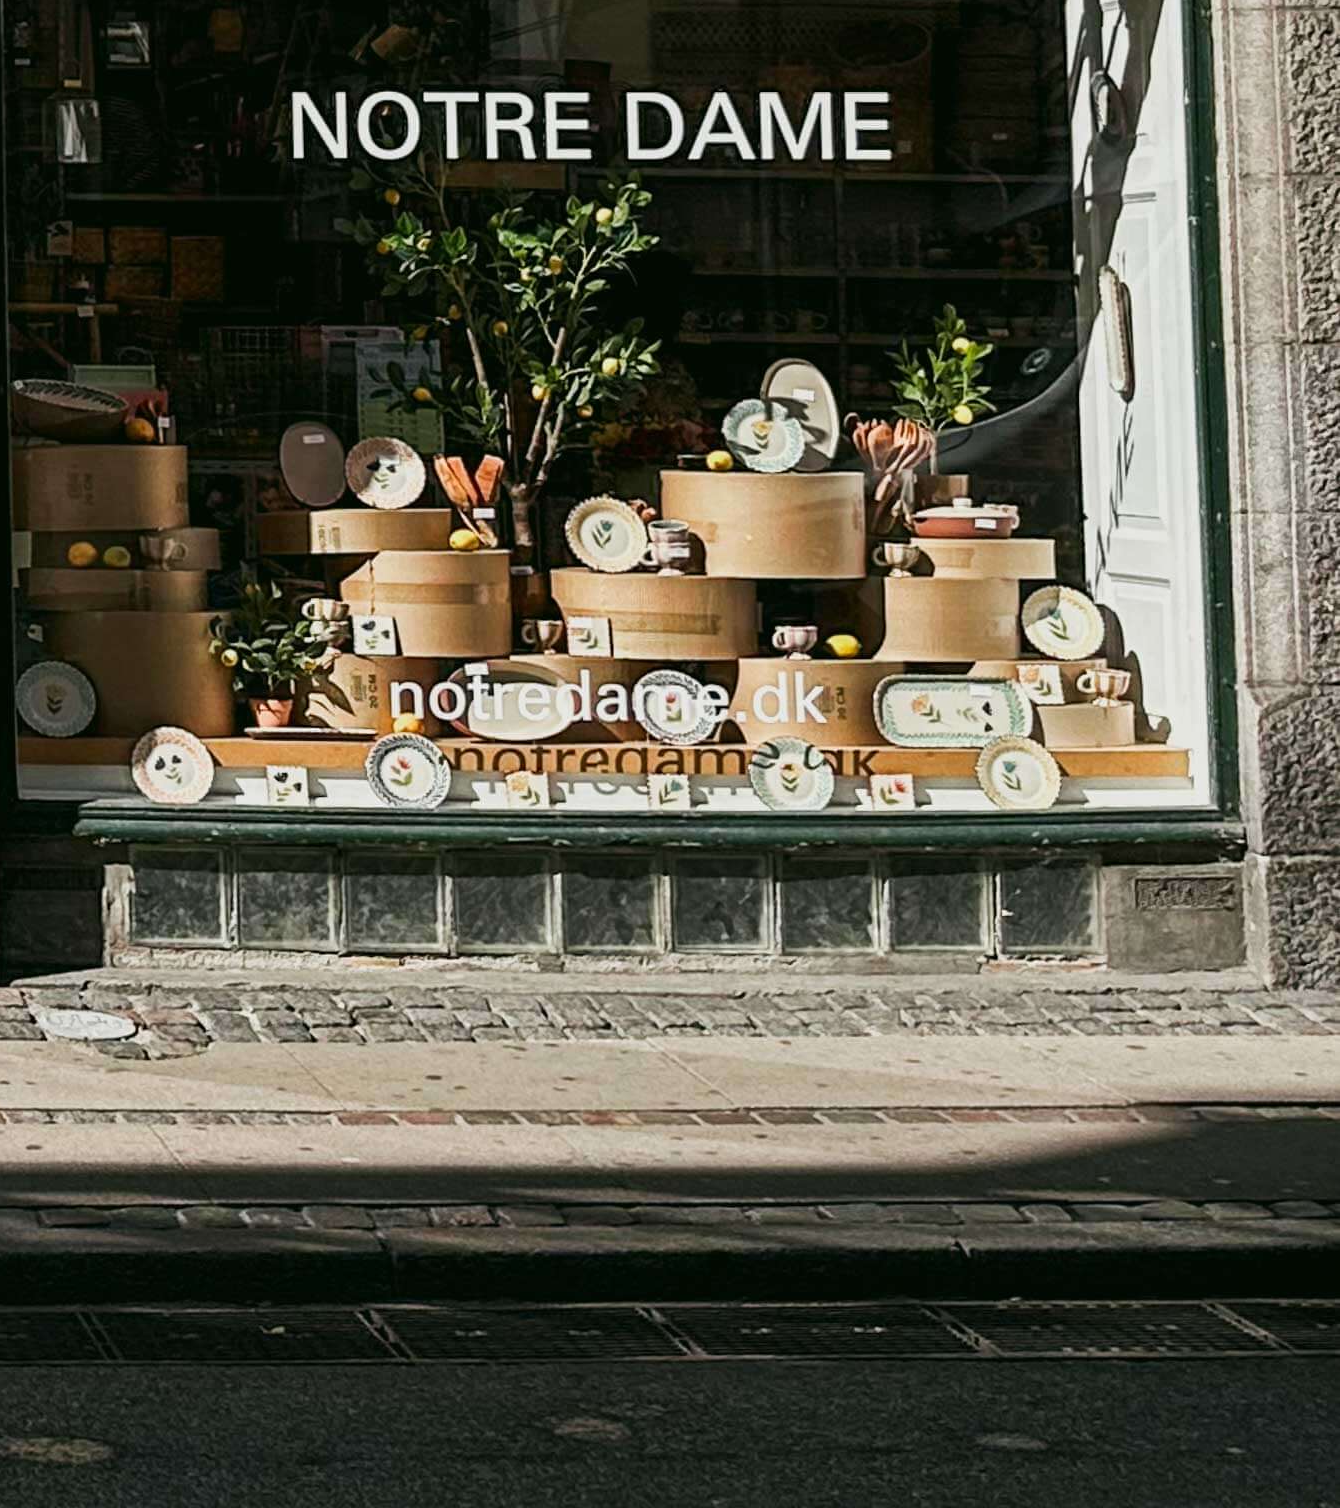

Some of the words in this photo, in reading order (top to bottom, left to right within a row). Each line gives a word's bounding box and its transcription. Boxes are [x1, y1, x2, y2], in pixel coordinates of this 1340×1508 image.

[291, 90, 592, 161] NOTRE
[625, 91, 893, 161] DAME
[389, 668, 828, 725] notredame.dk
